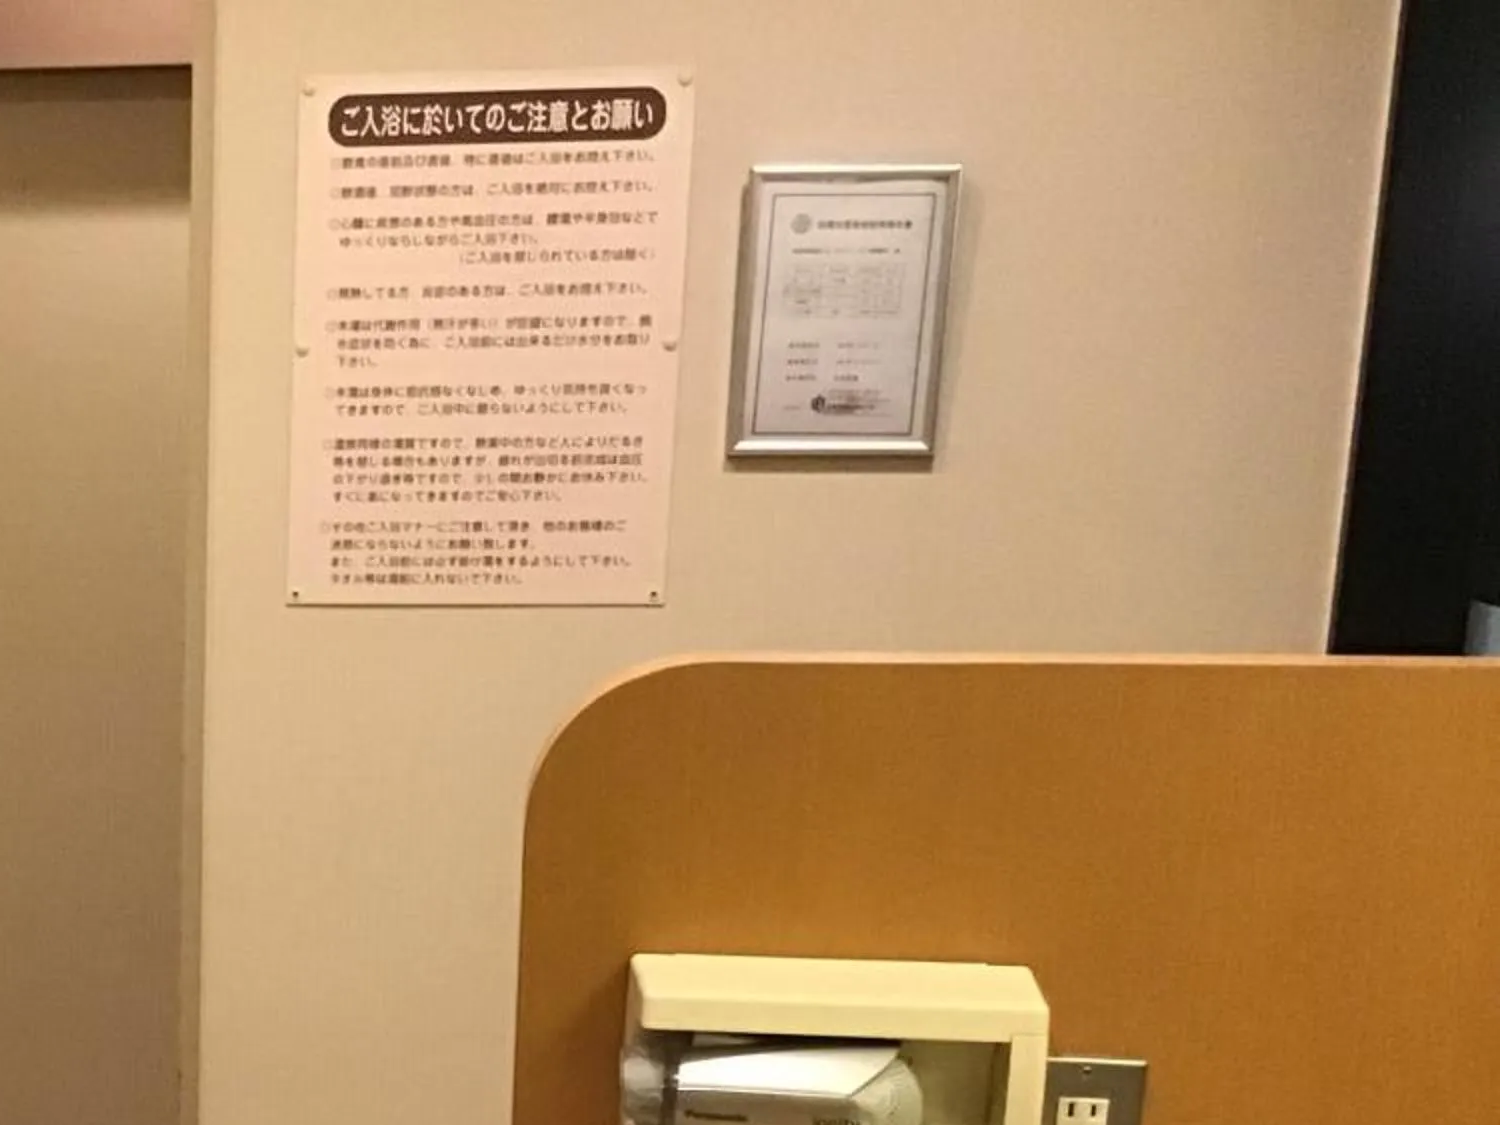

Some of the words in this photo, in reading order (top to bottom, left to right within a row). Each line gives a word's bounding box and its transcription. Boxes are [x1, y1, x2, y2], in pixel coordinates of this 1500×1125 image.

[340, 98, 654, 137] ご入浴に於いてのご注意とお願い
